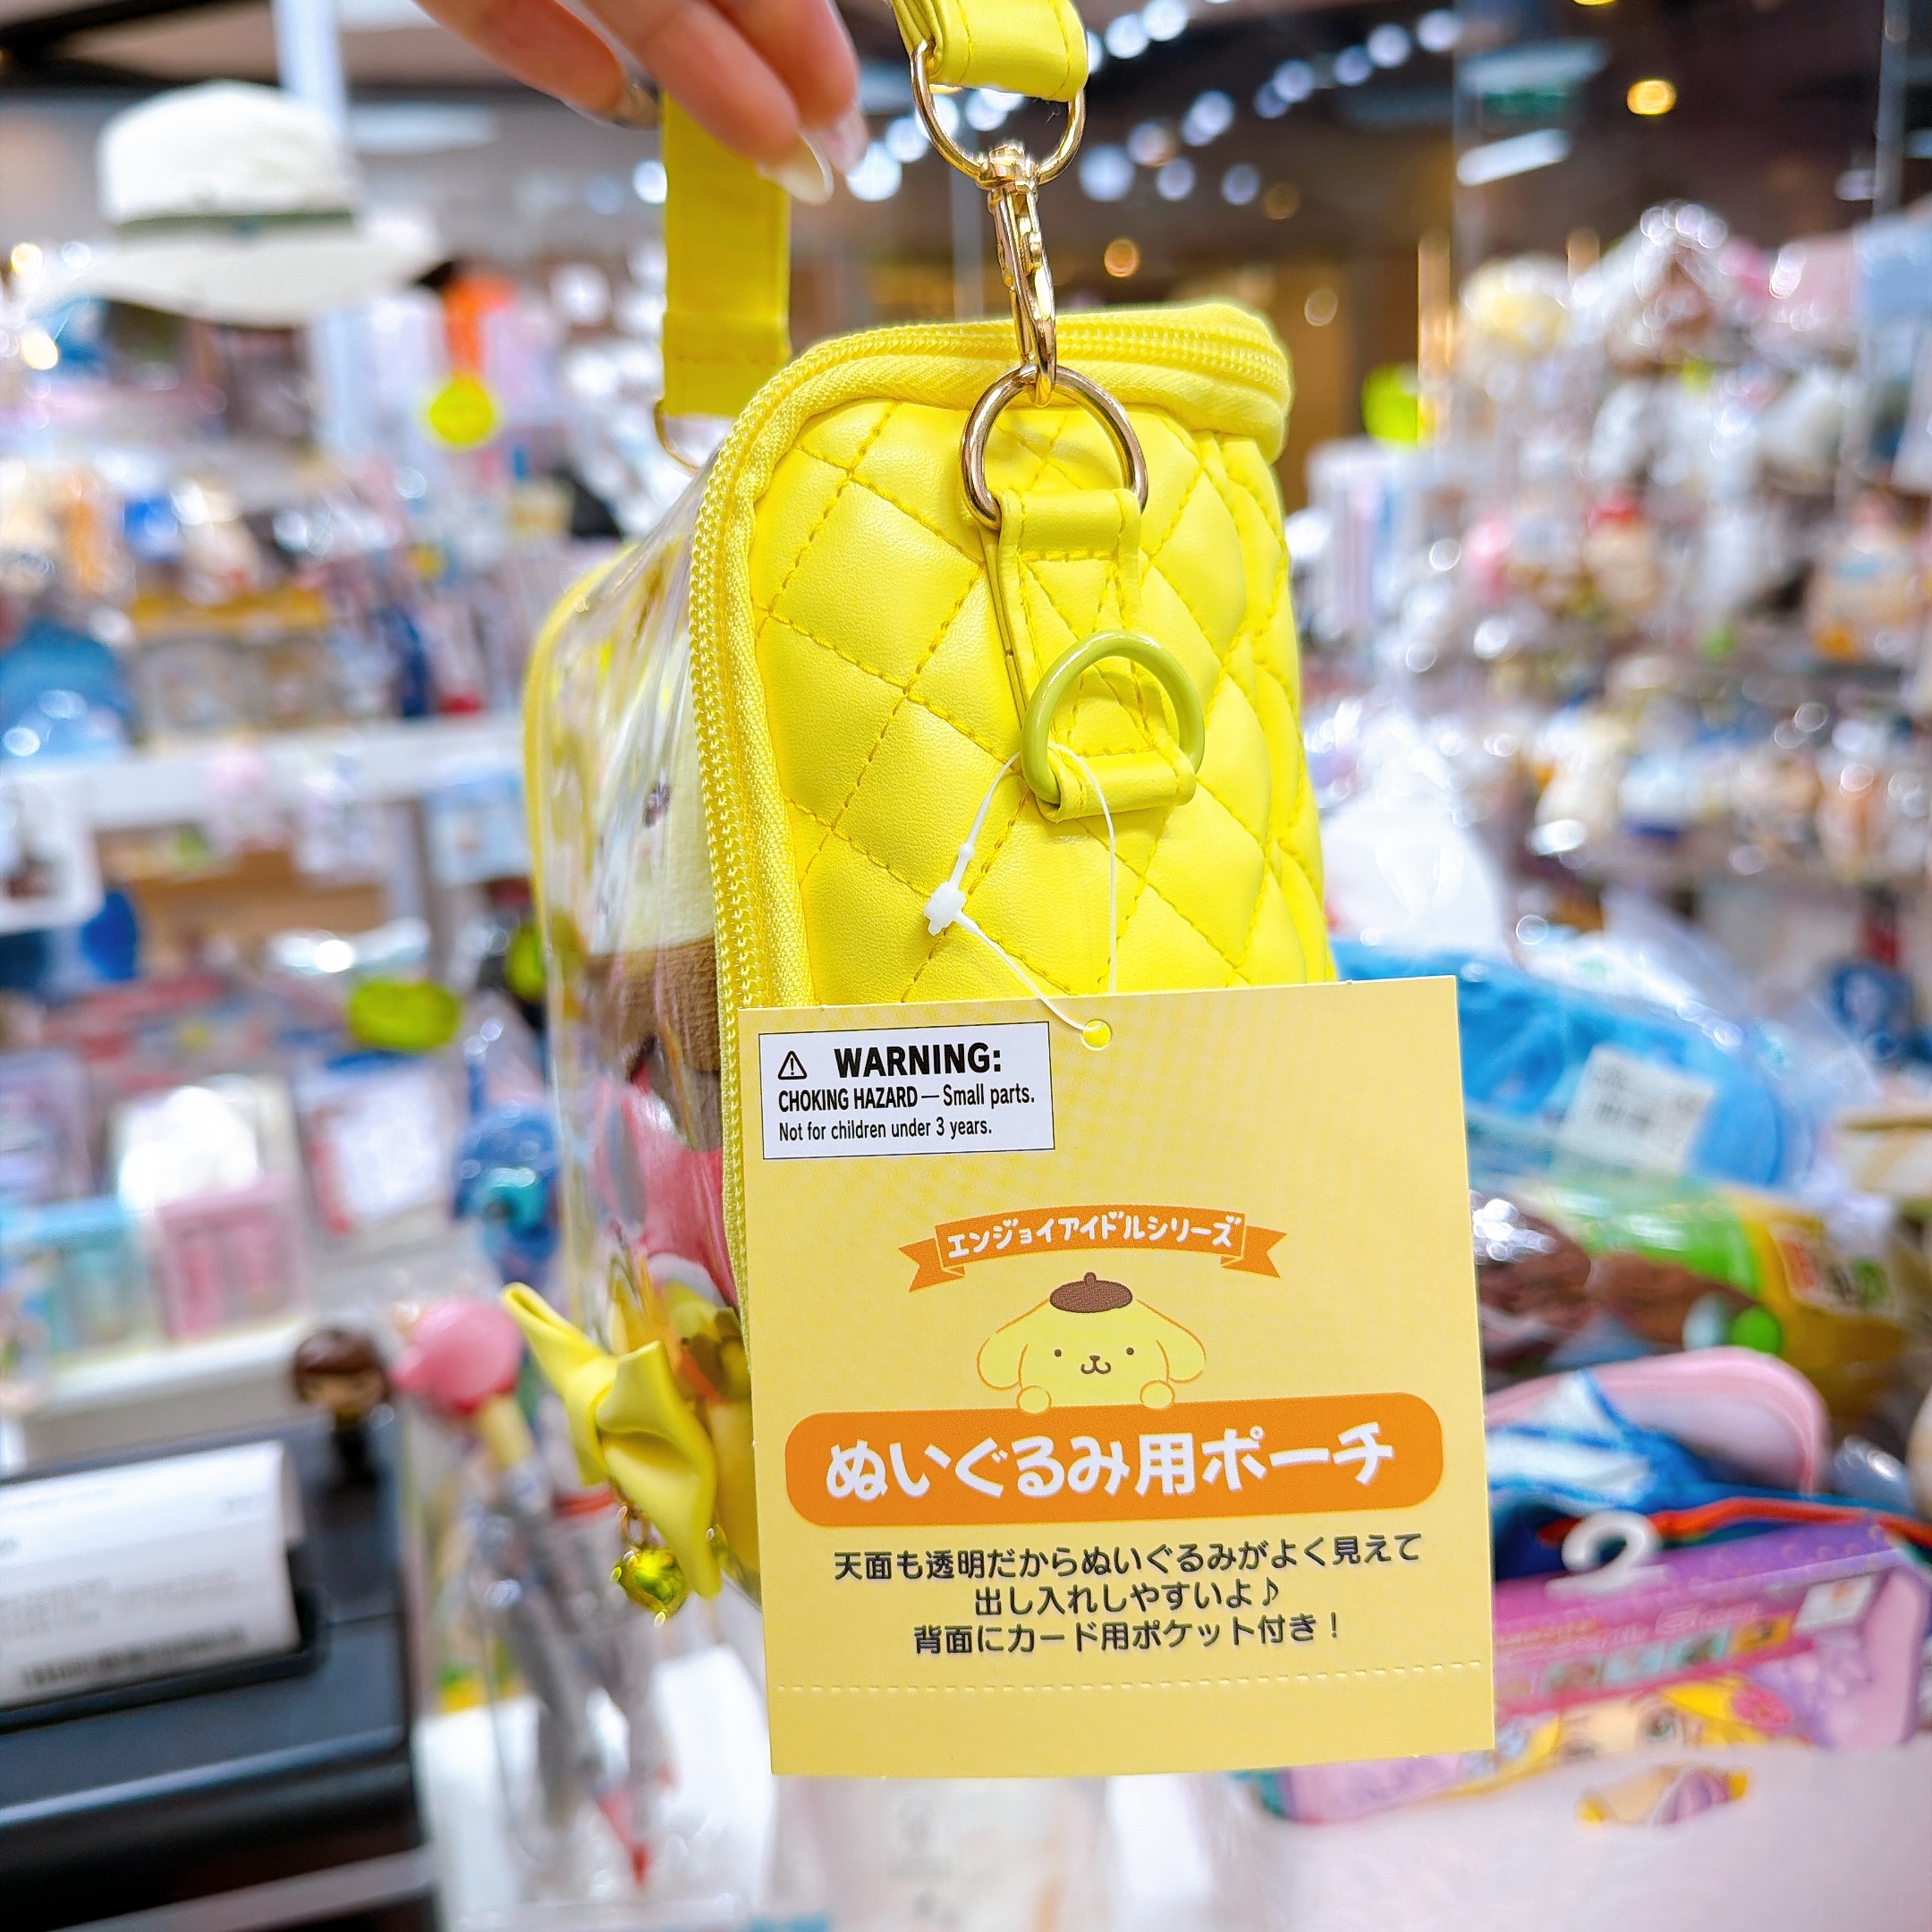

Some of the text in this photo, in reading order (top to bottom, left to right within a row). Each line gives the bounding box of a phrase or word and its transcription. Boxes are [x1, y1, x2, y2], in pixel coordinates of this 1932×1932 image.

[834, 1042, 1002, 1078] WARNING:
[777, 1089, 849, 1113] CHOKING
[990, 1082, 1036, 1109] parts.
[779, 1116, 993, 1141] Not for children under 3 years.
[947, 1210, 1242, 1258] エンジョイアイドルシリーズ
[826, 1421, 1394, 1503] ぬいぐるみ用ポーチ
[834, 1532, 1423, 1580] 天面も透明だからぬいぐるみがよく見えて
